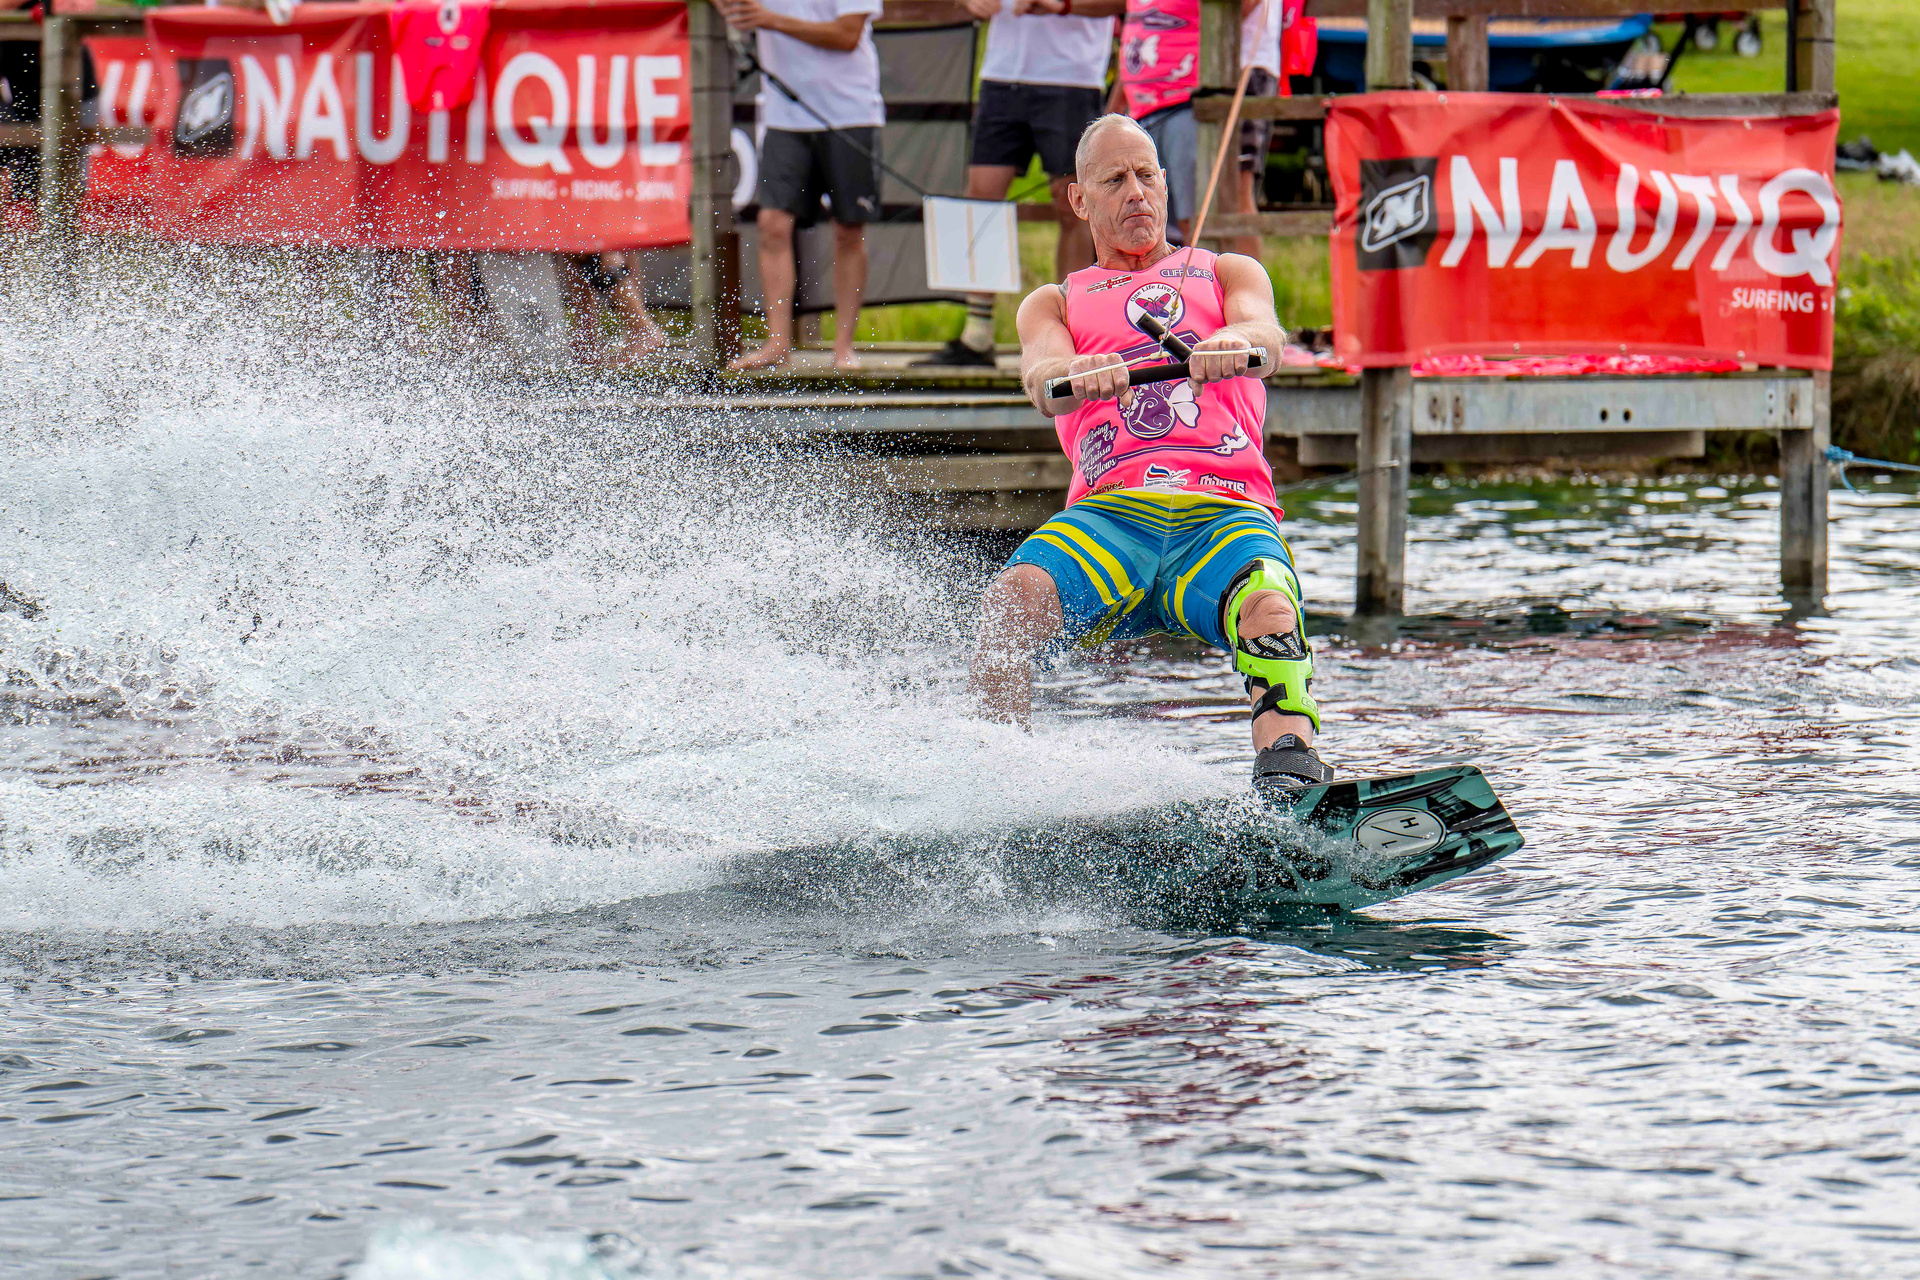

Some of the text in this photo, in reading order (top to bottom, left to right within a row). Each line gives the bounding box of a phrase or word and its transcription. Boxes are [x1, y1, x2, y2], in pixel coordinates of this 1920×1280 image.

[1440, 155, 1840, 287] NAUTIQ
[1160, 269, 1214, 282] CLIFF LAKES
[1130, 290, 1142, 302] One
[1141, 284, 1156, 293] Life
[1157, 284, 1172, 293] Live
[1731, 287, 1815, 314] SURFING
[1086, 458, 1117, 486] Fellows
